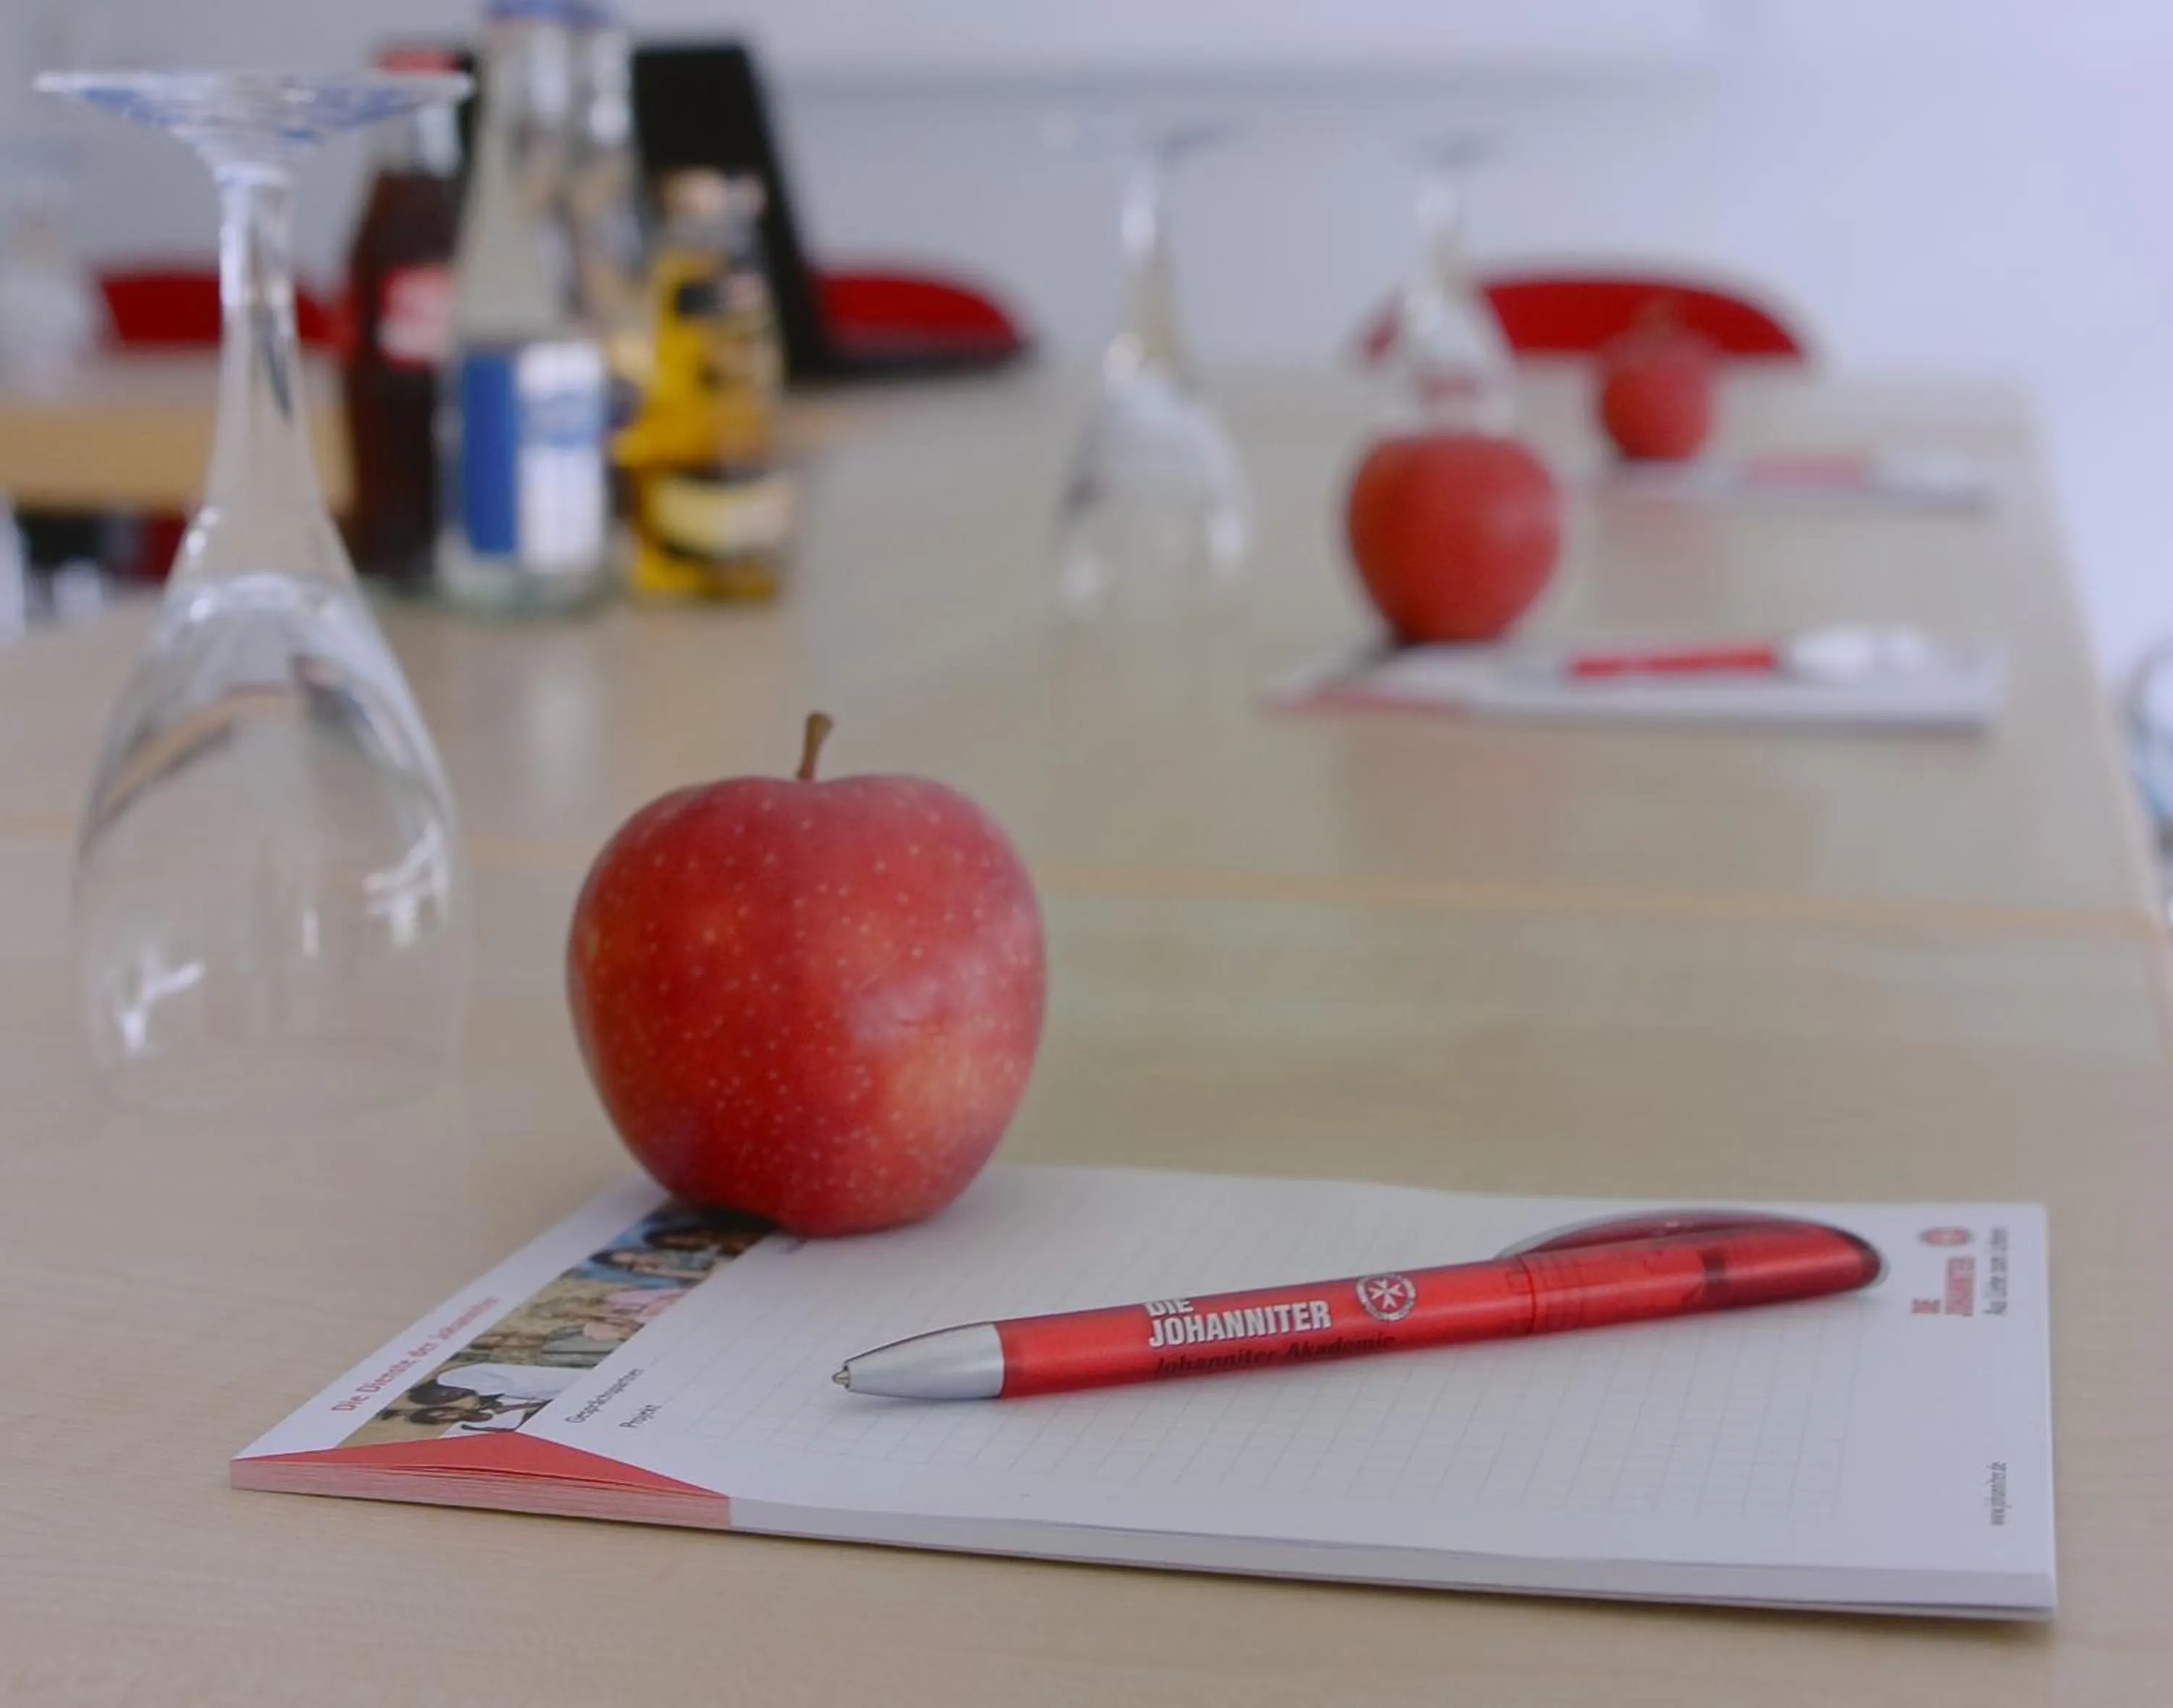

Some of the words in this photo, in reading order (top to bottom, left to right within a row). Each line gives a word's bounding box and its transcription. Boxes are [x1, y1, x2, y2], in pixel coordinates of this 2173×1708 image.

[1148, 1301, 1333, 1347] JOHANNITER
[1154, 1347, 1276, 1376] Johanniter
[330, 1394, 370, 1412] Die
